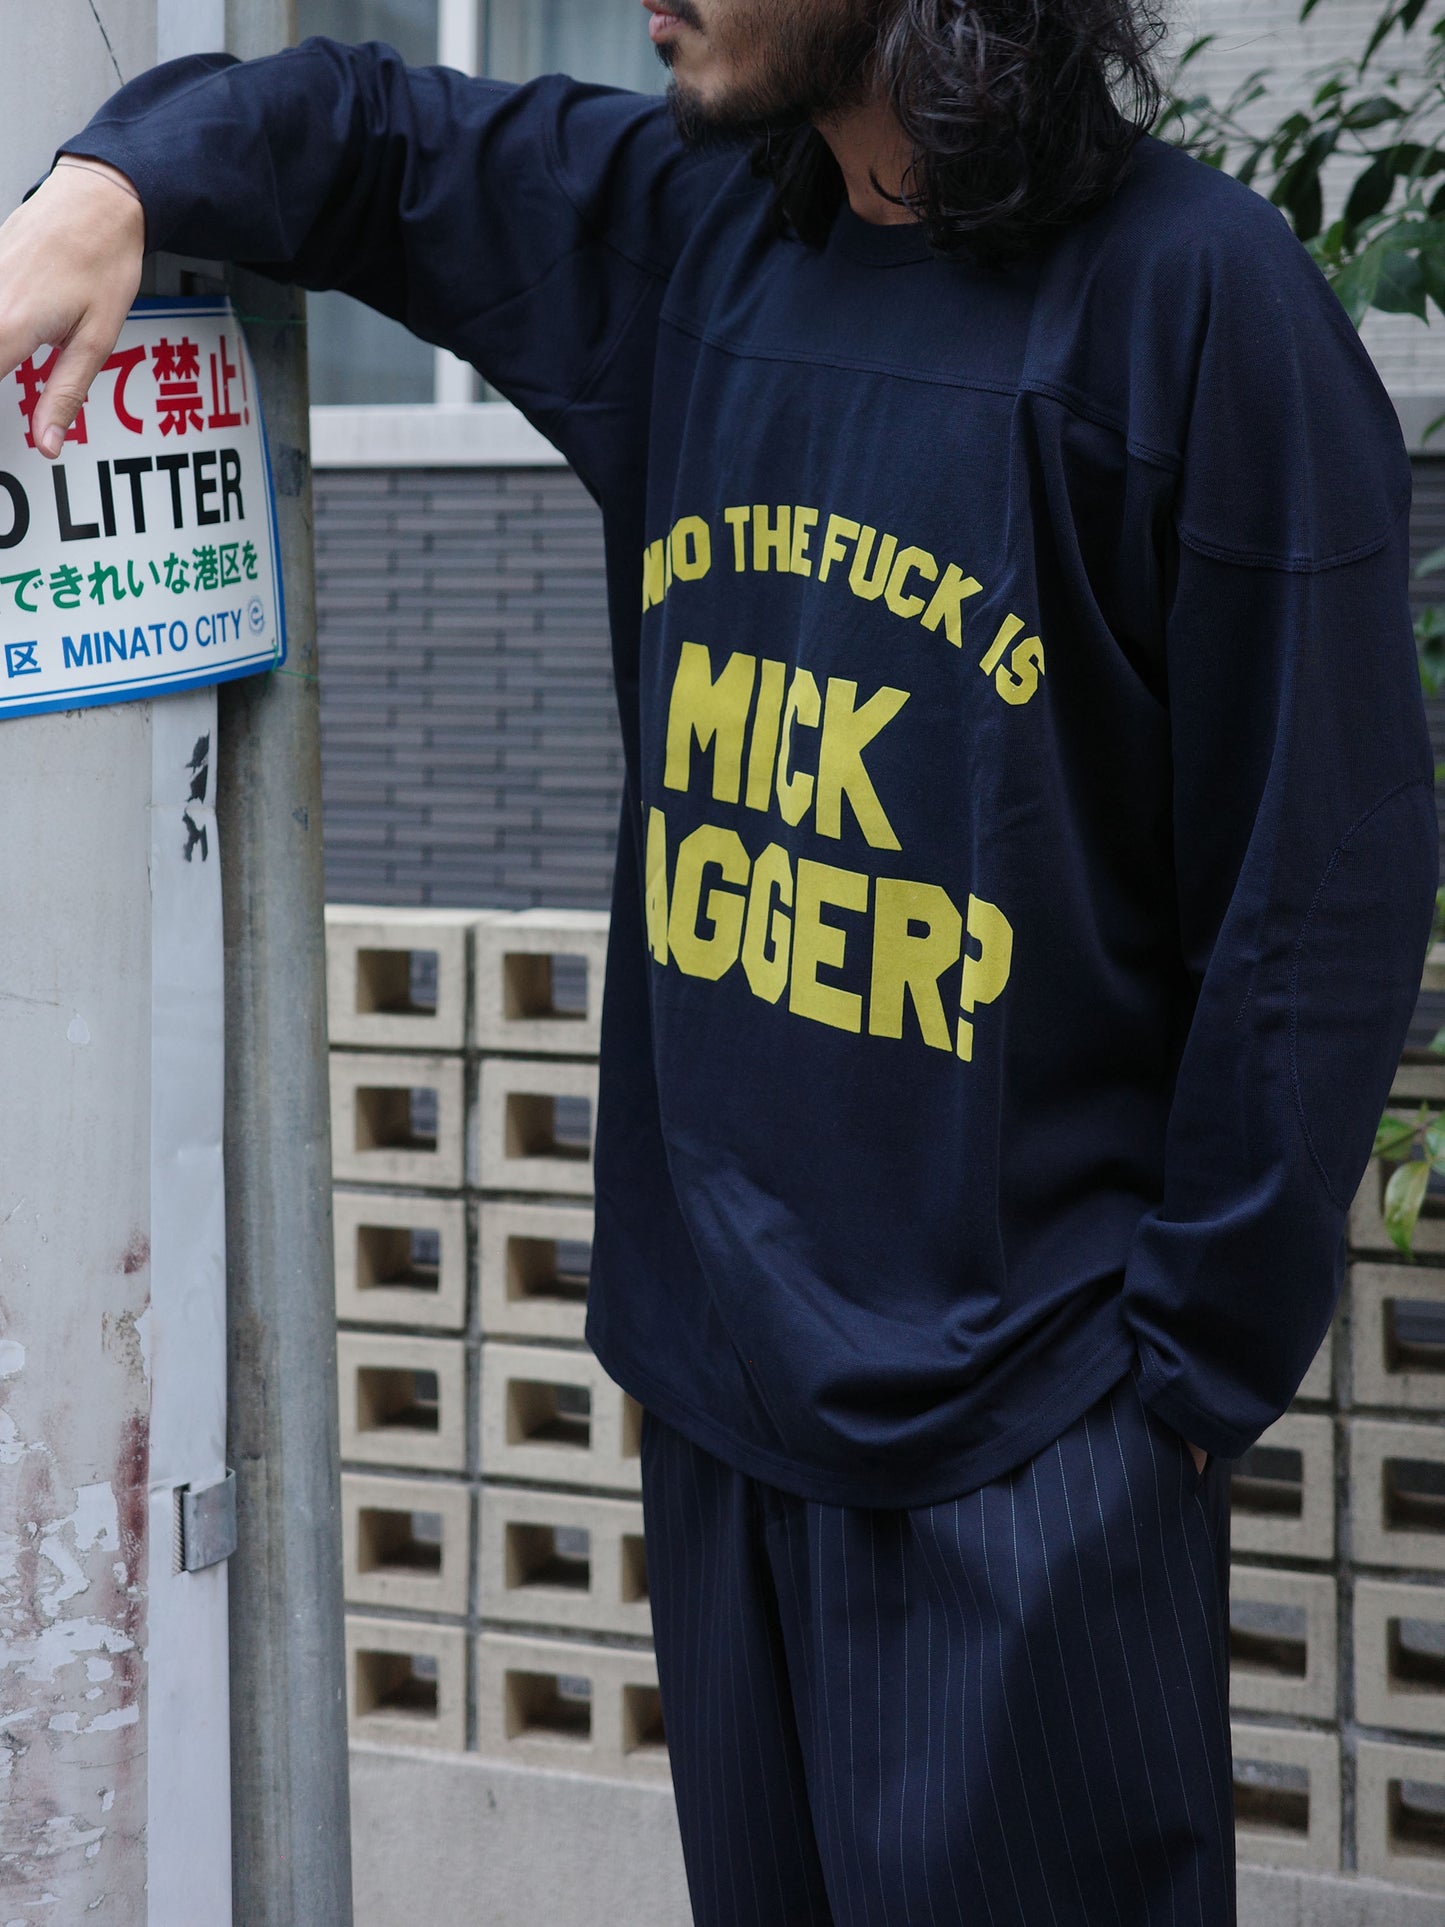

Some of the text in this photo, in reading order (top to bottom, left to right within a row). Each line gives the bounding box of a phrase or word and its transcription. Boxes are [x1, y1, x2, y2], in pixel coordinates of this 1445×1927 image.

[51, 448, 245, 542] LITTER
[0, 541, 258, 613] できれいな港区を
[4, 608, 242, 678] 区 MINATO CITY
[724, 504, 819, 577] THE
[818, 514, 983, 648] FUCK
[979, 613, 1045, 706] IS
[663, 641, 911, 852] MICK
[643, 806, 1014, 1062] AGGER?
